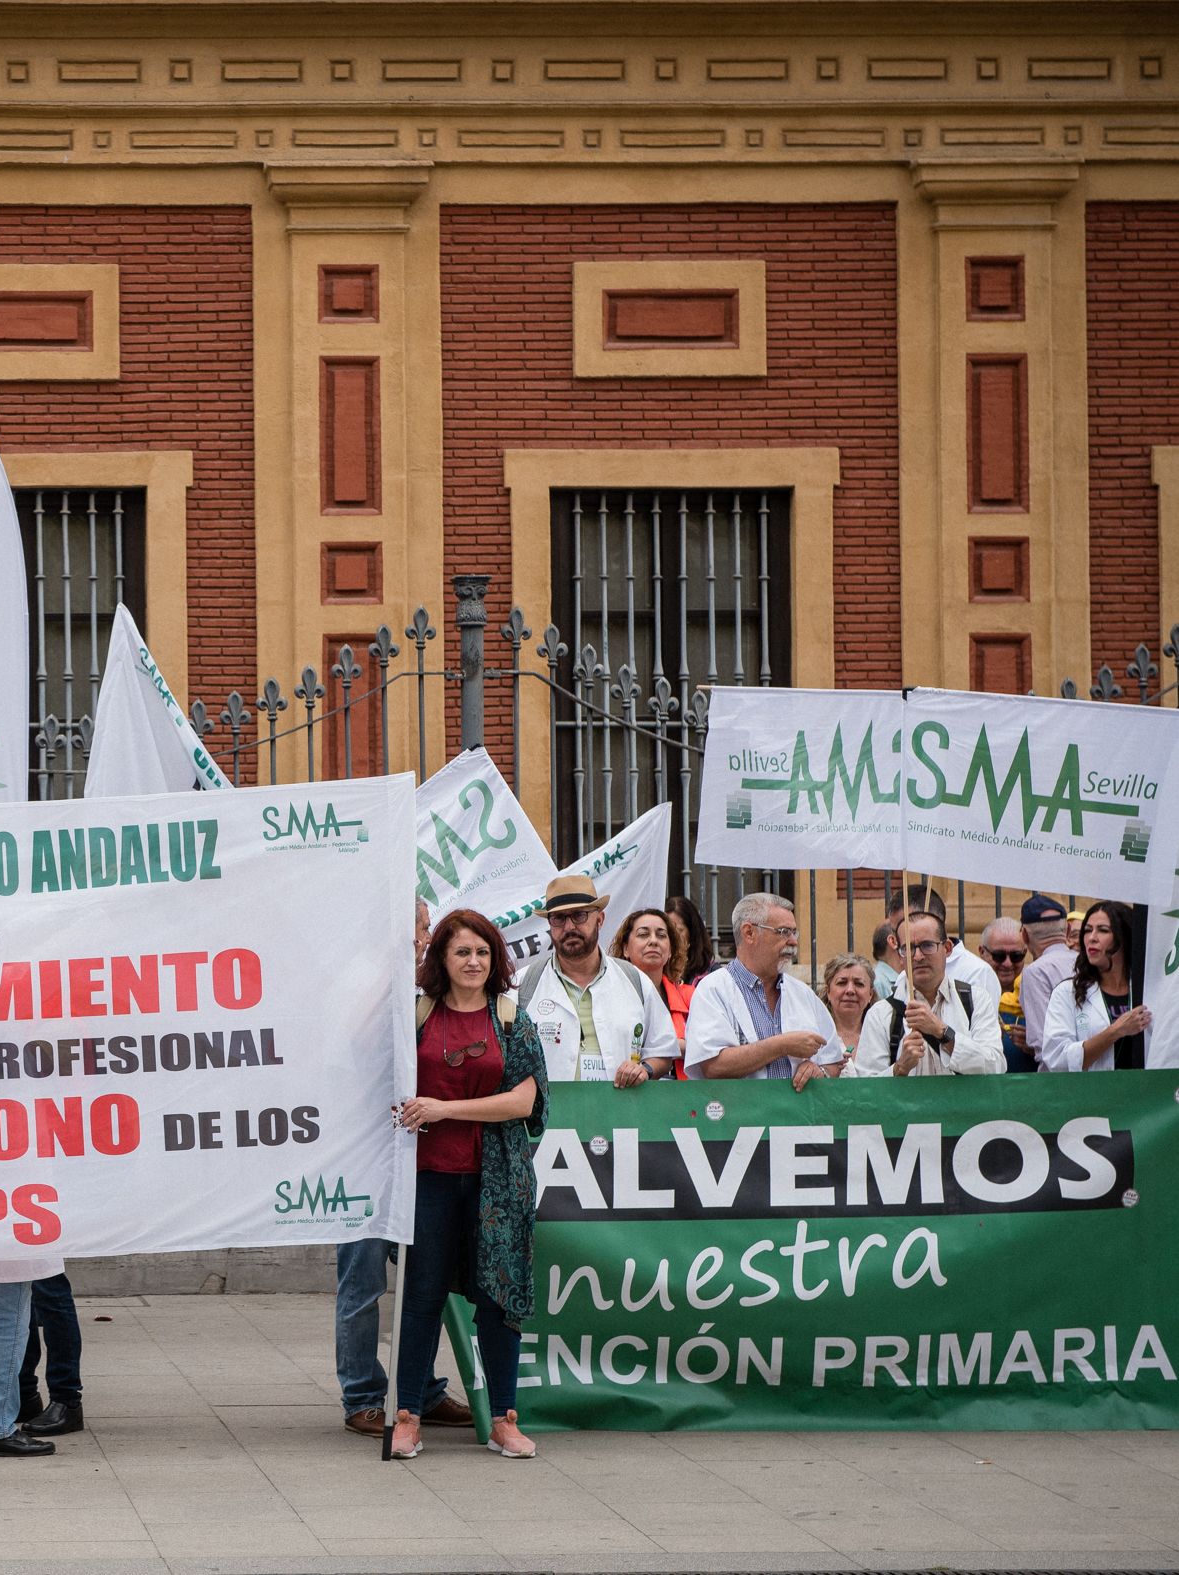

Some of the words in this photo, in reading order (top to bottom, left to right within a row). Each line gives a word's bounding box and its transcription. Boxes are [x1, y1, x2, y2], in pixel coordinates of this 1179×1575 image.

[907, 720, 1140, 838] SMA
[1083, 770, 1159, 800] Sevilla
[262, 799, 363, 843] SMA
[907, 819, 956, 839] Sindicato
[960, 830, 1000, 847] Médico
[1002, 835, 1044, 852] Andaluz
[1053, 842, 1112, 861] Federación
[31, 819, 222, 894] ANDALUZ
[583, 1059, 606, 1071] SEVILL
[163, 1111, 224, 1152] DE
[235, 1105, 321, 1148] LOS
[532, 1116, 1117, 1210] ALVEMOS
[274, 1173, 371, 1217] SMA
[547, 1219, 948, 1315] nuestra
[473, 1322, 784, 1390] ENCIÓN
[812, 1324, 1178, 1388] PRIMARIA
